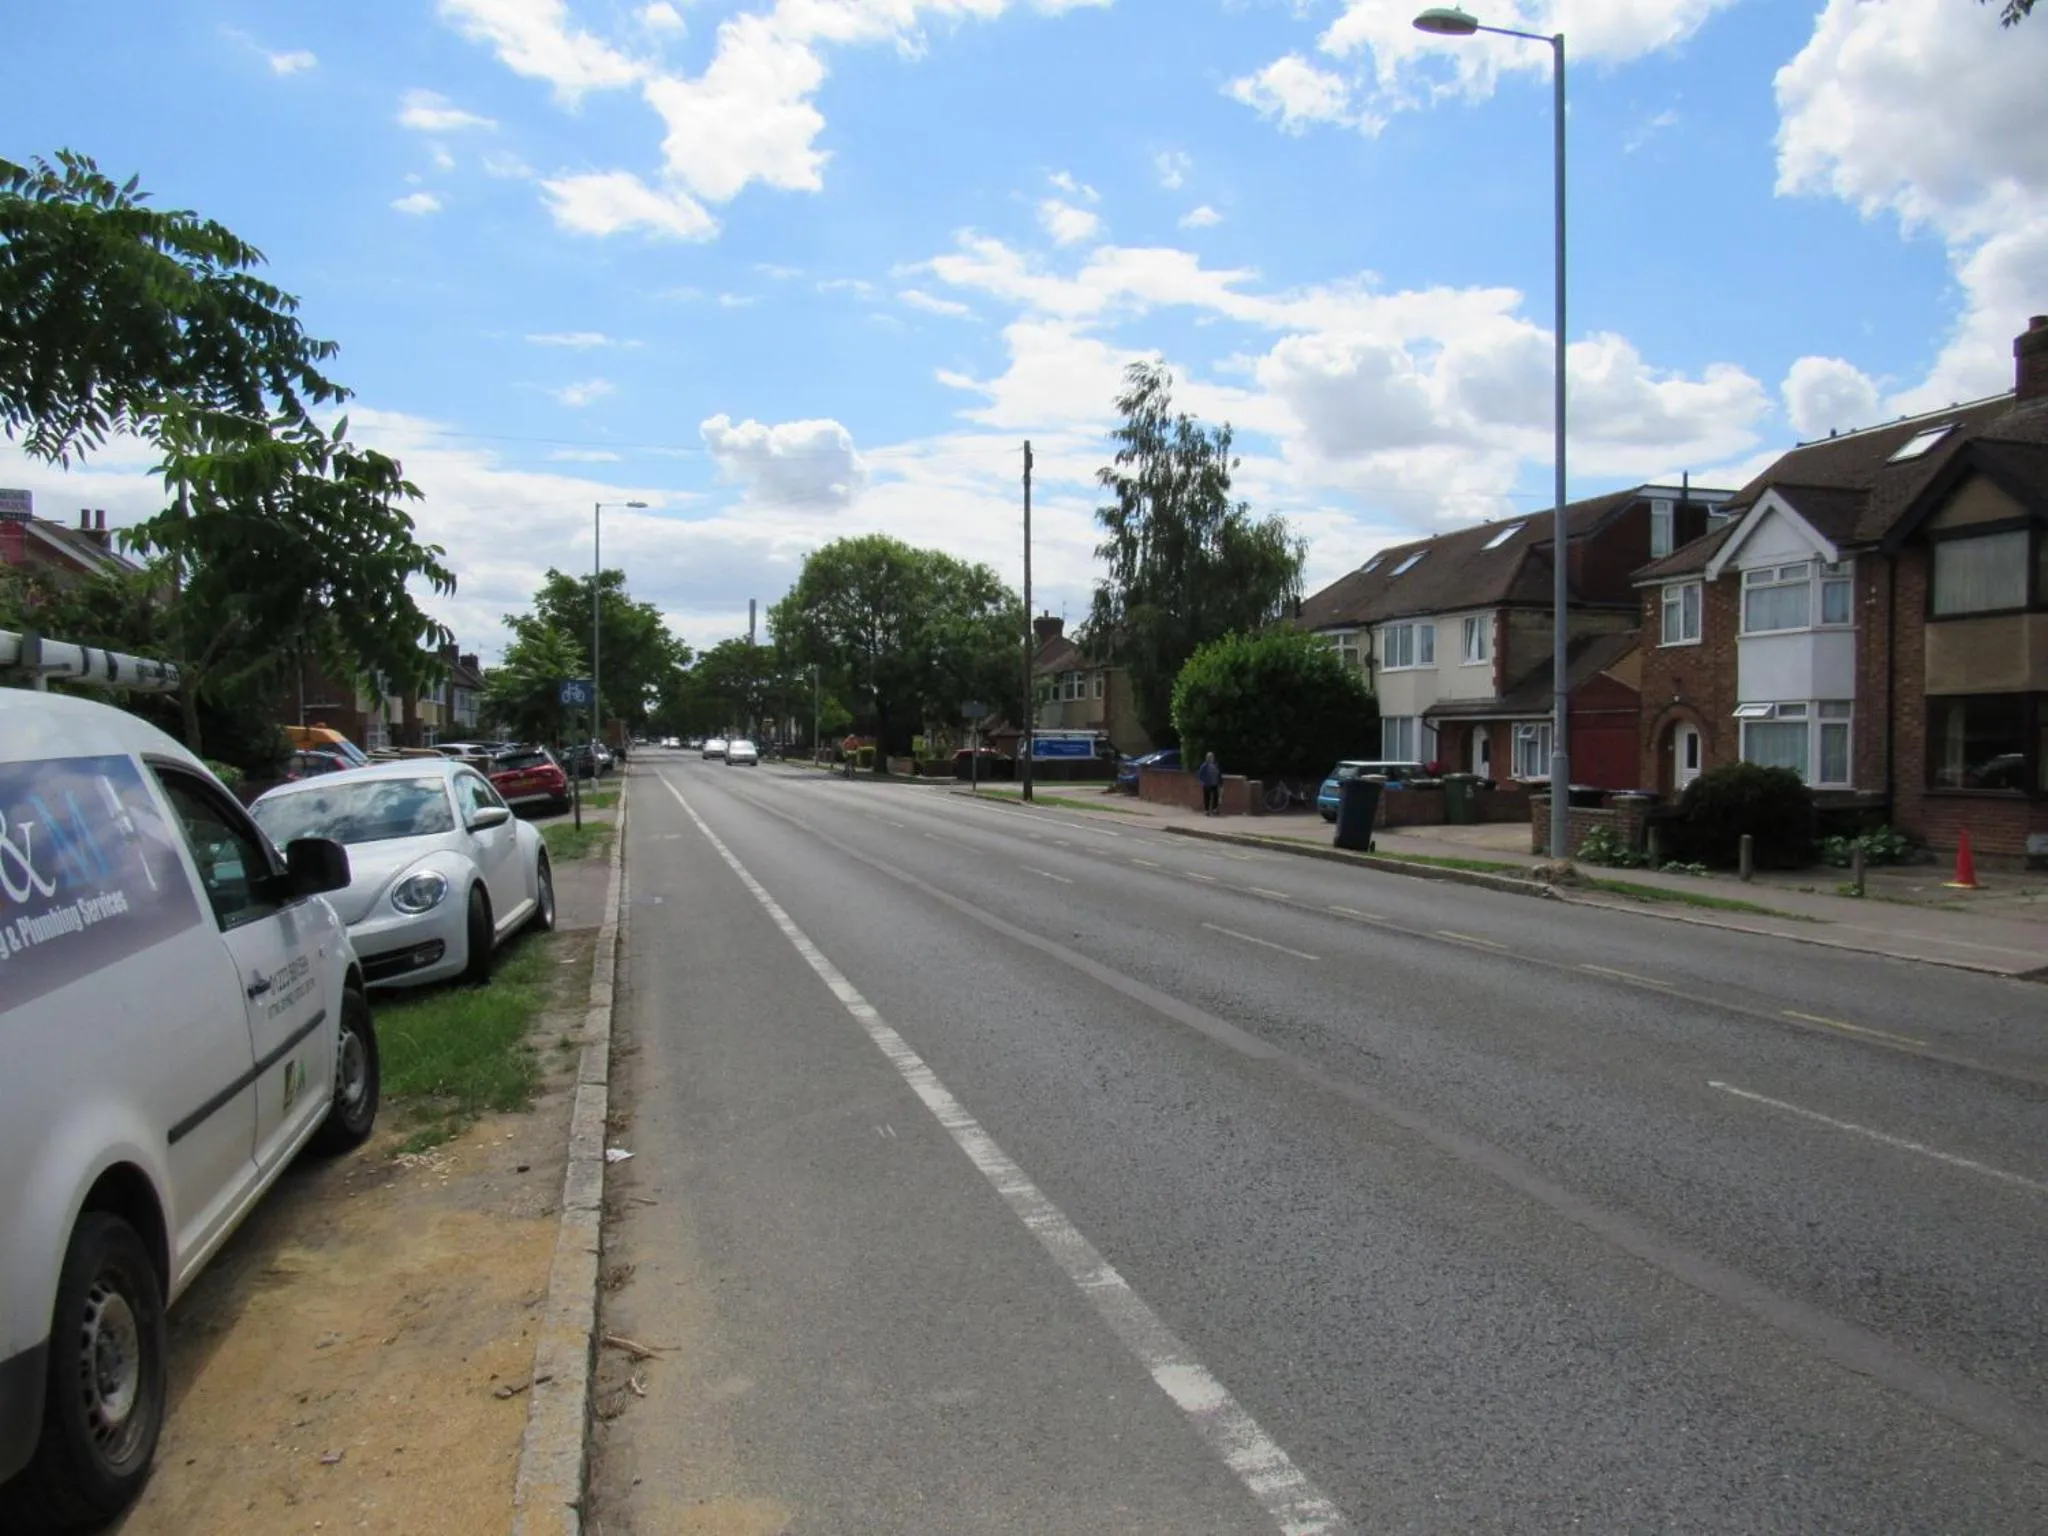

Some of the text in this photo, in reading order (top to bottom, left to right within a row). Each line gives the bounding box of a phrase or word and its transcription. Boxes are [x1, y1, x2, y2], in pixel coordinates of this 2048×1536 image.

[5, 926, 23, 953] &
[16, 905, 84, 948] Plumbing
[77, 890, 128, 926] Services
